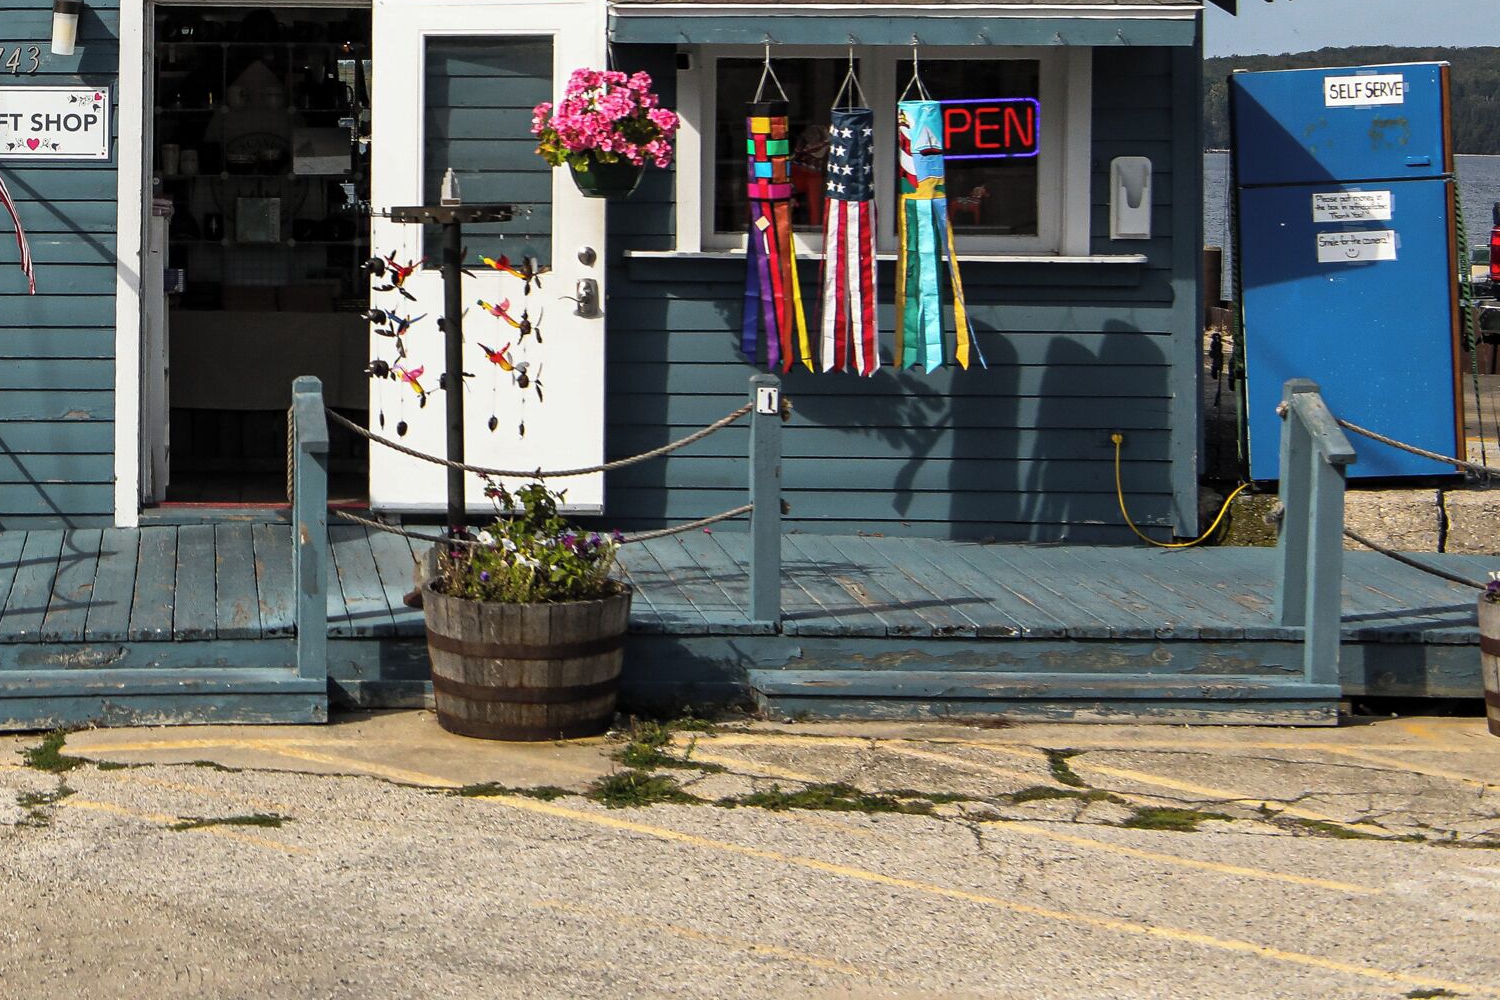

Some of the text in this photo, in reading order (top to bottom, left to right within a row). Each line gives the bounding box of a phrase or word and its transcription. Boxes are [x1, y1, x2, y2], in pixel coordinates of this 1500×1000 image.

[1329, 80, 1403, 100] SELF SERVE
[30, 113, 98, 132] SHOP
[944, 106, 1034, 150] PEN
[1315, 194, 1338, 203] Please
[1318, 236, 1339, 247] Smile
